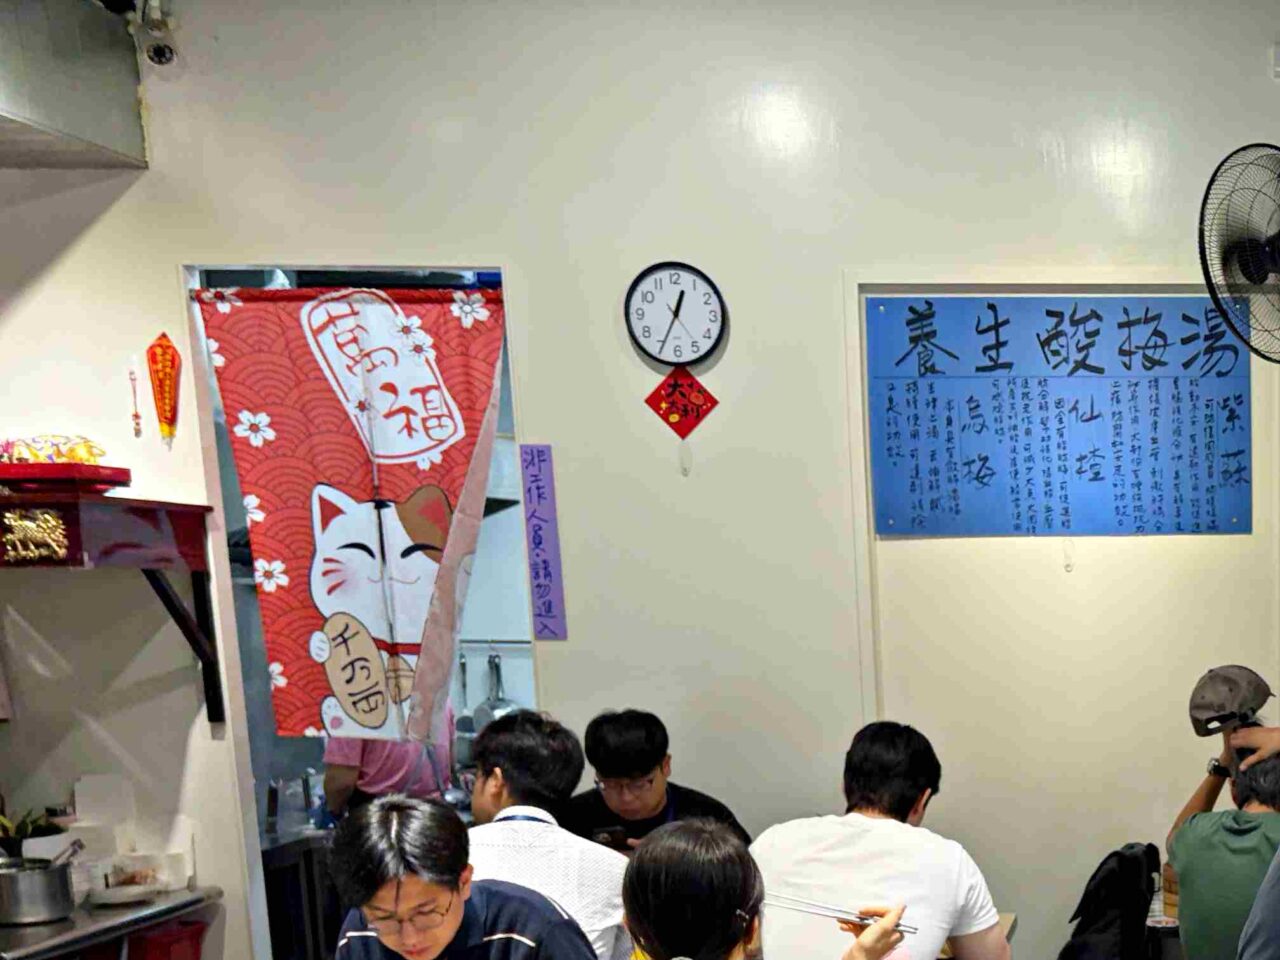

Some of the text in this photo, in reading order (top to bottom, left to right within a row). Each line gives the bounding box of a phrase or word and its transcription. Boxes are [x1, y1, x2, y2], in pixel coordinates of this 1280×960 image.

[654, 278, 663, 290] 11
[669, 272, 681, 285] 12
[641, 290, 655, 304] 10
[703, 292, 712, 305] 2
[635, 307, 645, 321] 9
[708, 310, 718, 323] 3
[642, 325, 651, 338] 8
[703, 327, 712, 340] 4
[895, 299, 1240, 378] 養生酸梅湯
[673, 345, 683, 357] 6
[691, 340, 700, 353] 5
[961, 393, 996, 489] 烏梅
